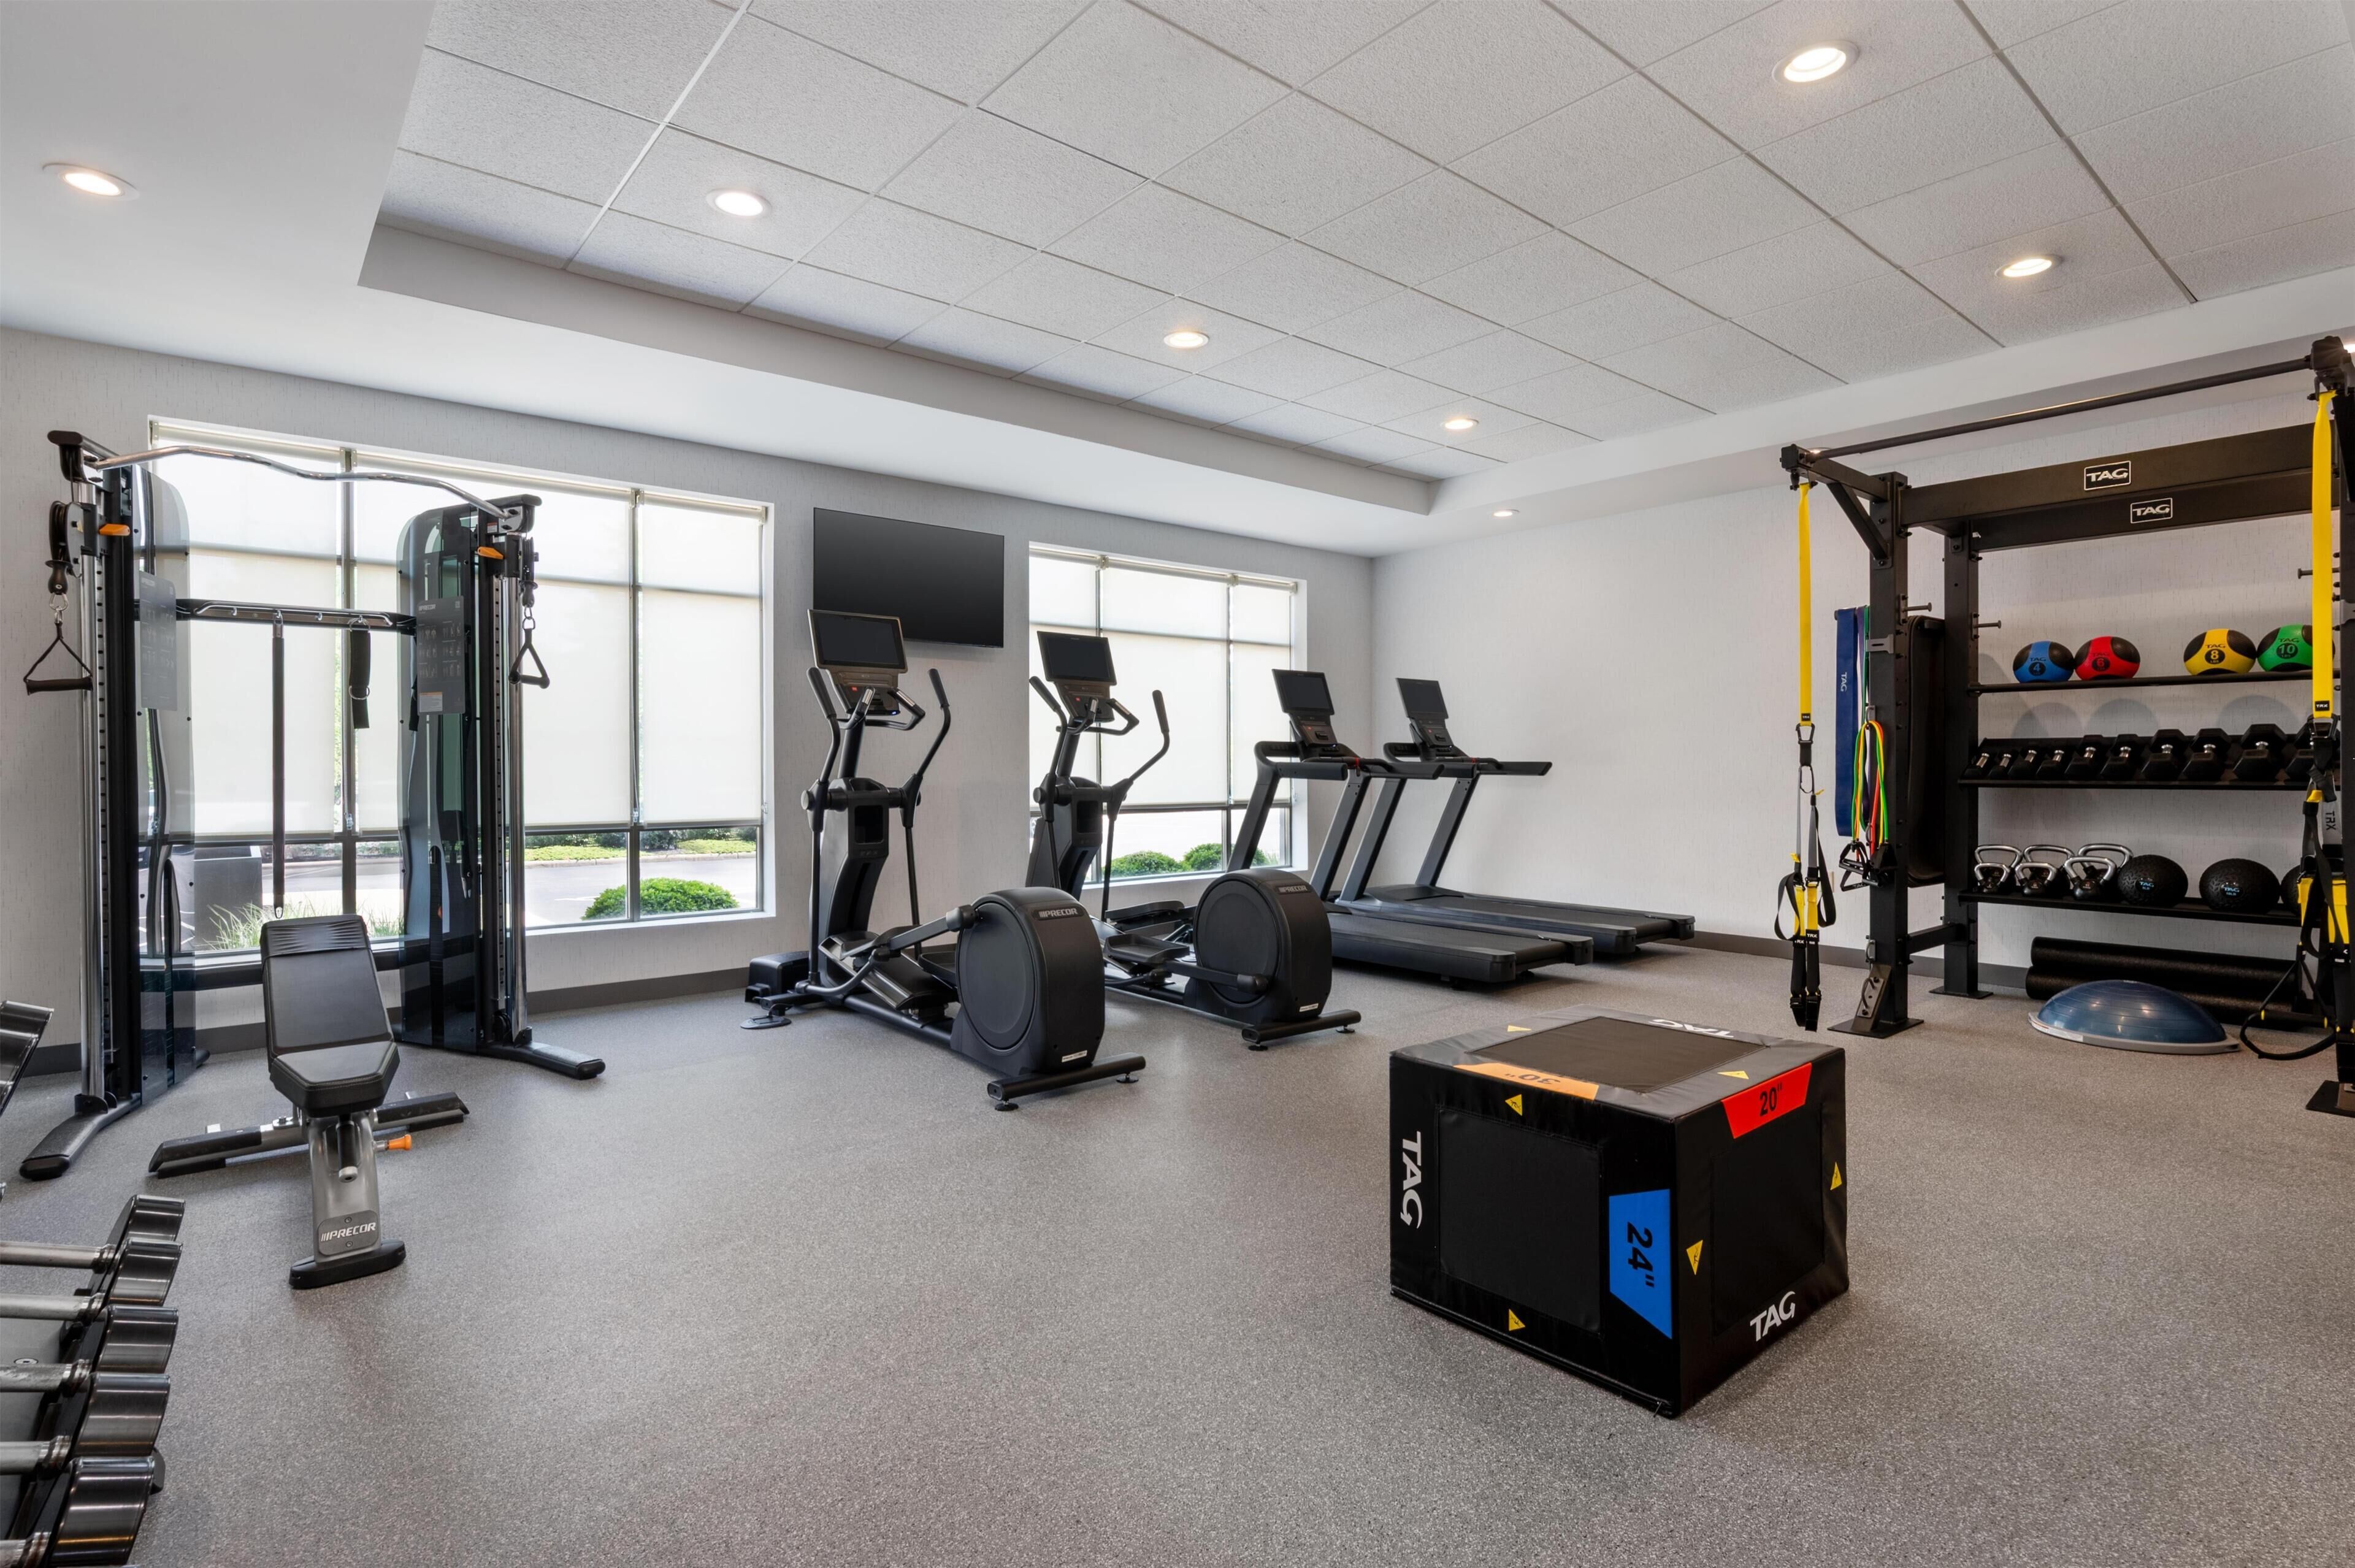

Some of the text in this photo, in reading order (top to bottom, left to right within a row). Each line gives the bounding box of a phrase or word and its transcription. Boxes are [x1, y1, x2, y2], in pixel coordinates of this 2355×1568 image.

[2086, 468, 2128, 482] TAG
[2132, 504, 2170, 516] TAG
[2210, 650, 2219, 660] 8
[2279, 644, 2296, 654] 10
[2033, 662, 2041, 673] 4
[2096, 658, 2105, 668] 6
[2326, 811, 2336, 830] TRX
[1044, 908, 1078, 917] PRECOR
[1648, 1019, 1734, 1038] TAG
[1504, 1073, 1561, 1085] 30"
[1760, 1082, 1782, 1117] 20"
[1400, 1131, 1423, 1229] TAG
[329, 1222, 377, 1240] PRECOR
[1627, 1221, 1655, 1288] 24"
[1750, 1291, 1796, 1342] TAG
